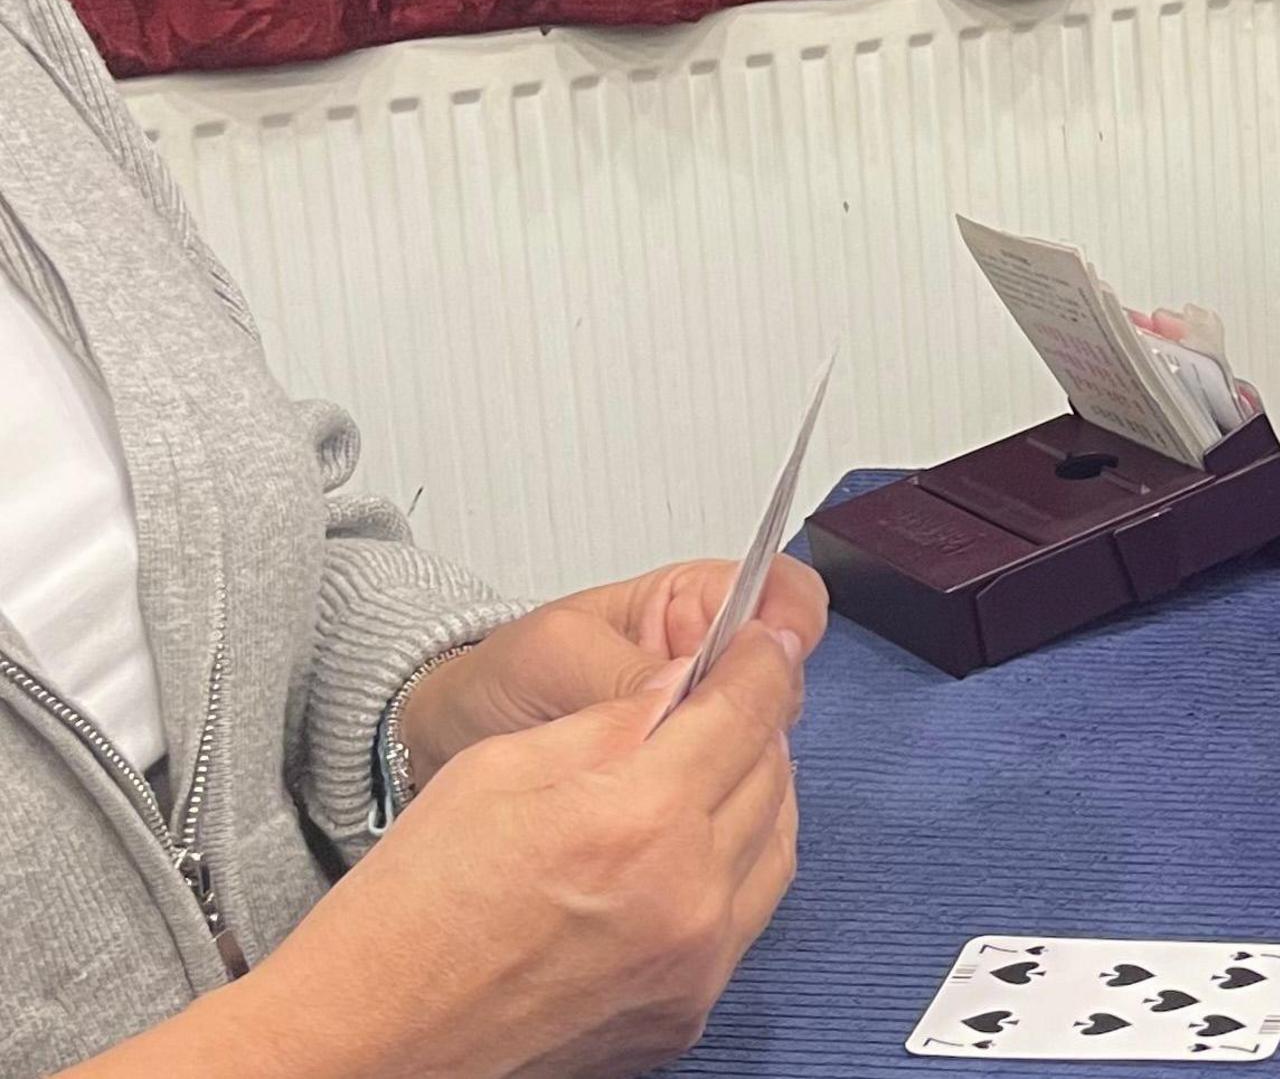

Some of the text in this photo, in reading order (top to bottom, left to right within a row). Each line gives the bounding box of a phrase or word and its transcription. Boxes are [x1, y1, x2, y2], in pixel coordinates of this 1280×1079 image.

[979, 943, 1019, 954] 7
[922, 1036, 965, 1048] 7
[1218, 1042, 1261, 1054] 7
